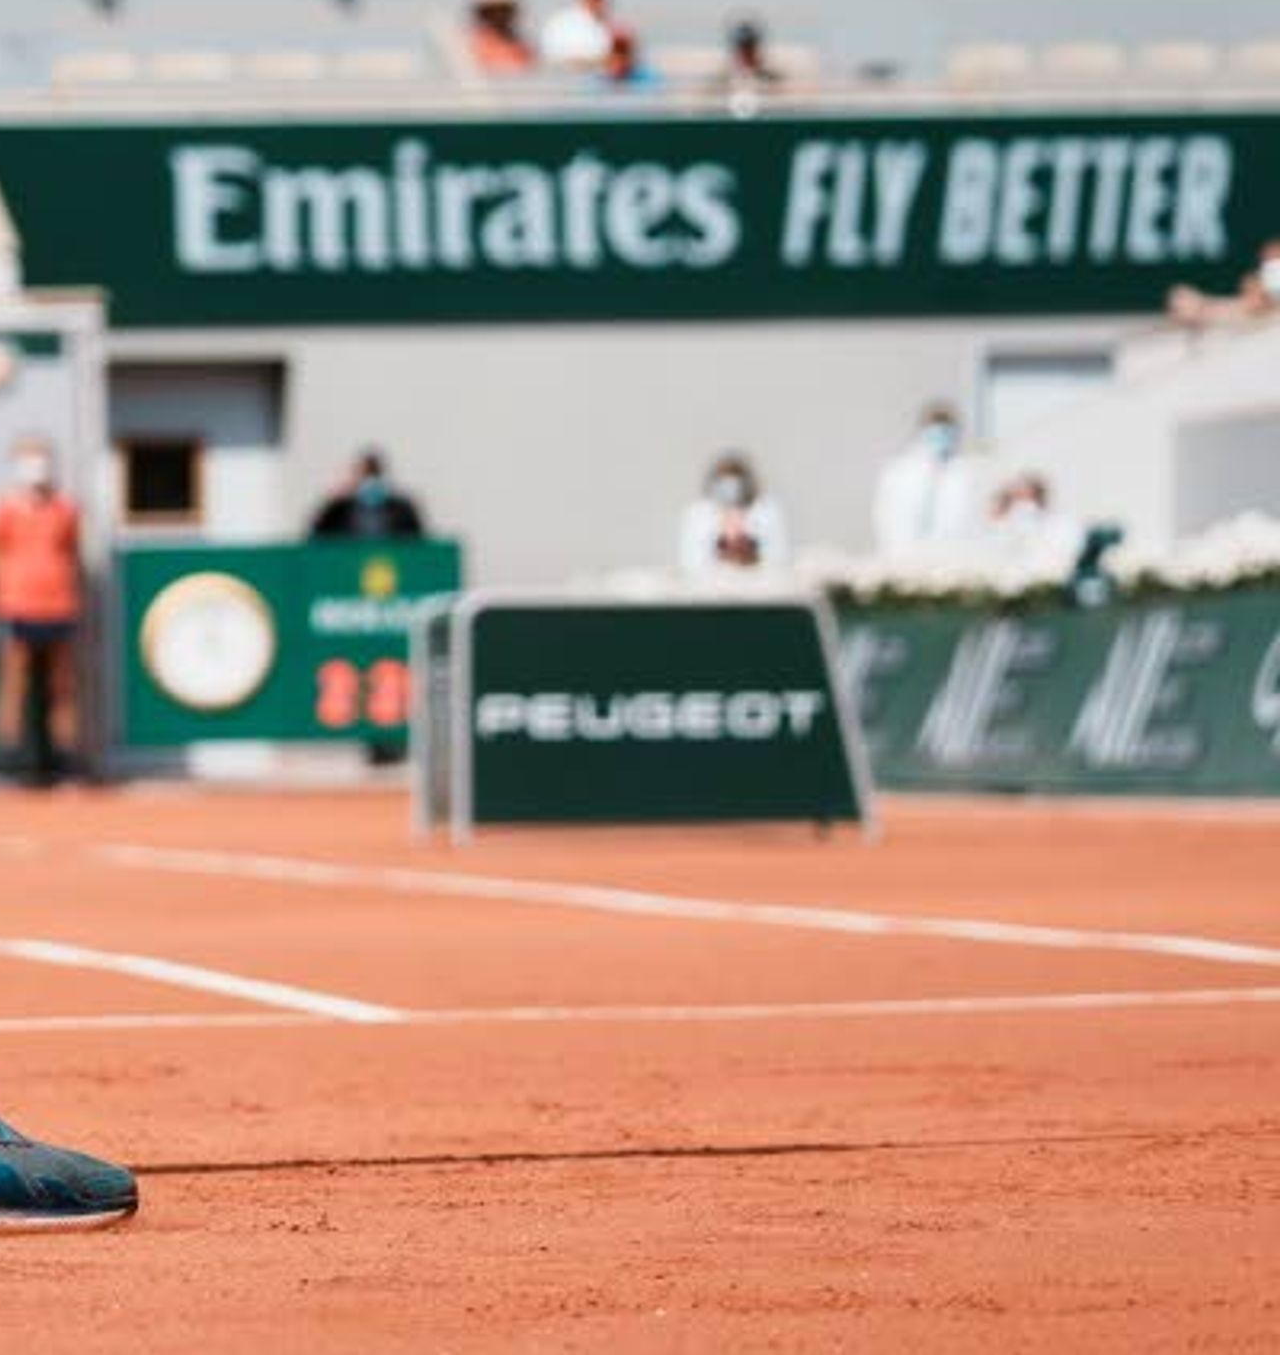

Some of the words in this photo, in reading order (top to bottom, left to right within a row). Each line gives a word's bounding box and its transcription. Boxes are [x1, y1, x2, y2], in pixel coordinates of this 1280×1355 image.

[170, 139, 740, 273] Emirates
[782, 137, 922, 263] FLY
[938, 133, 1232, 263] BETTER
[476, 689, 822, 739] PEUGEOT
